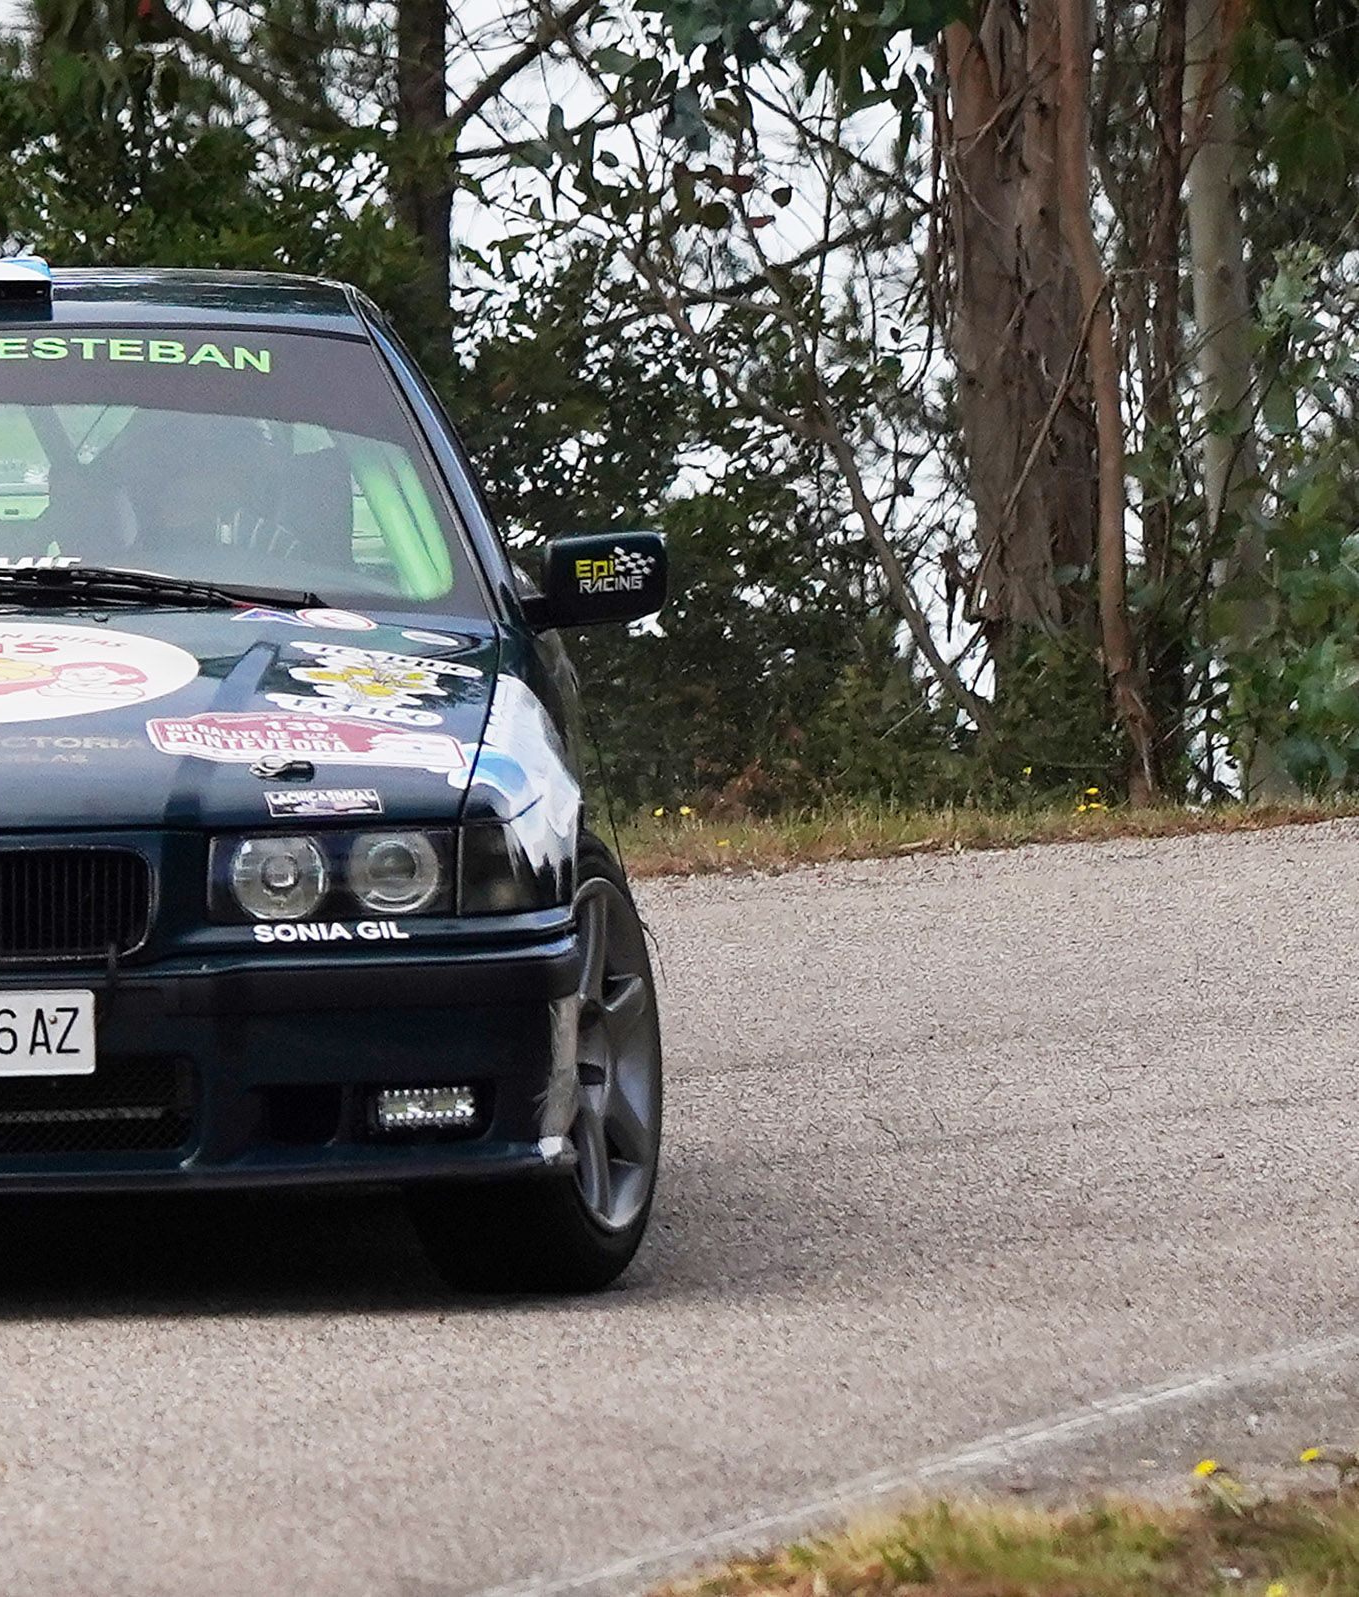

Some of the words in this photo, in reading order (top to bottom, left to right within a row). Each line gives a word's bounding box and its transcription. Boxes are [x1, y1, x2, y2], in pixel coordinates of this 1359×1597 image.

[578, 575, 643, 594] RACING
[166, 731, 352, 753] PONTEVEDRA
[195, 724, 261, 740] RALLYE
[253, 922, 352, 943] SONIA
[356, 920, 410, 941] GIL
